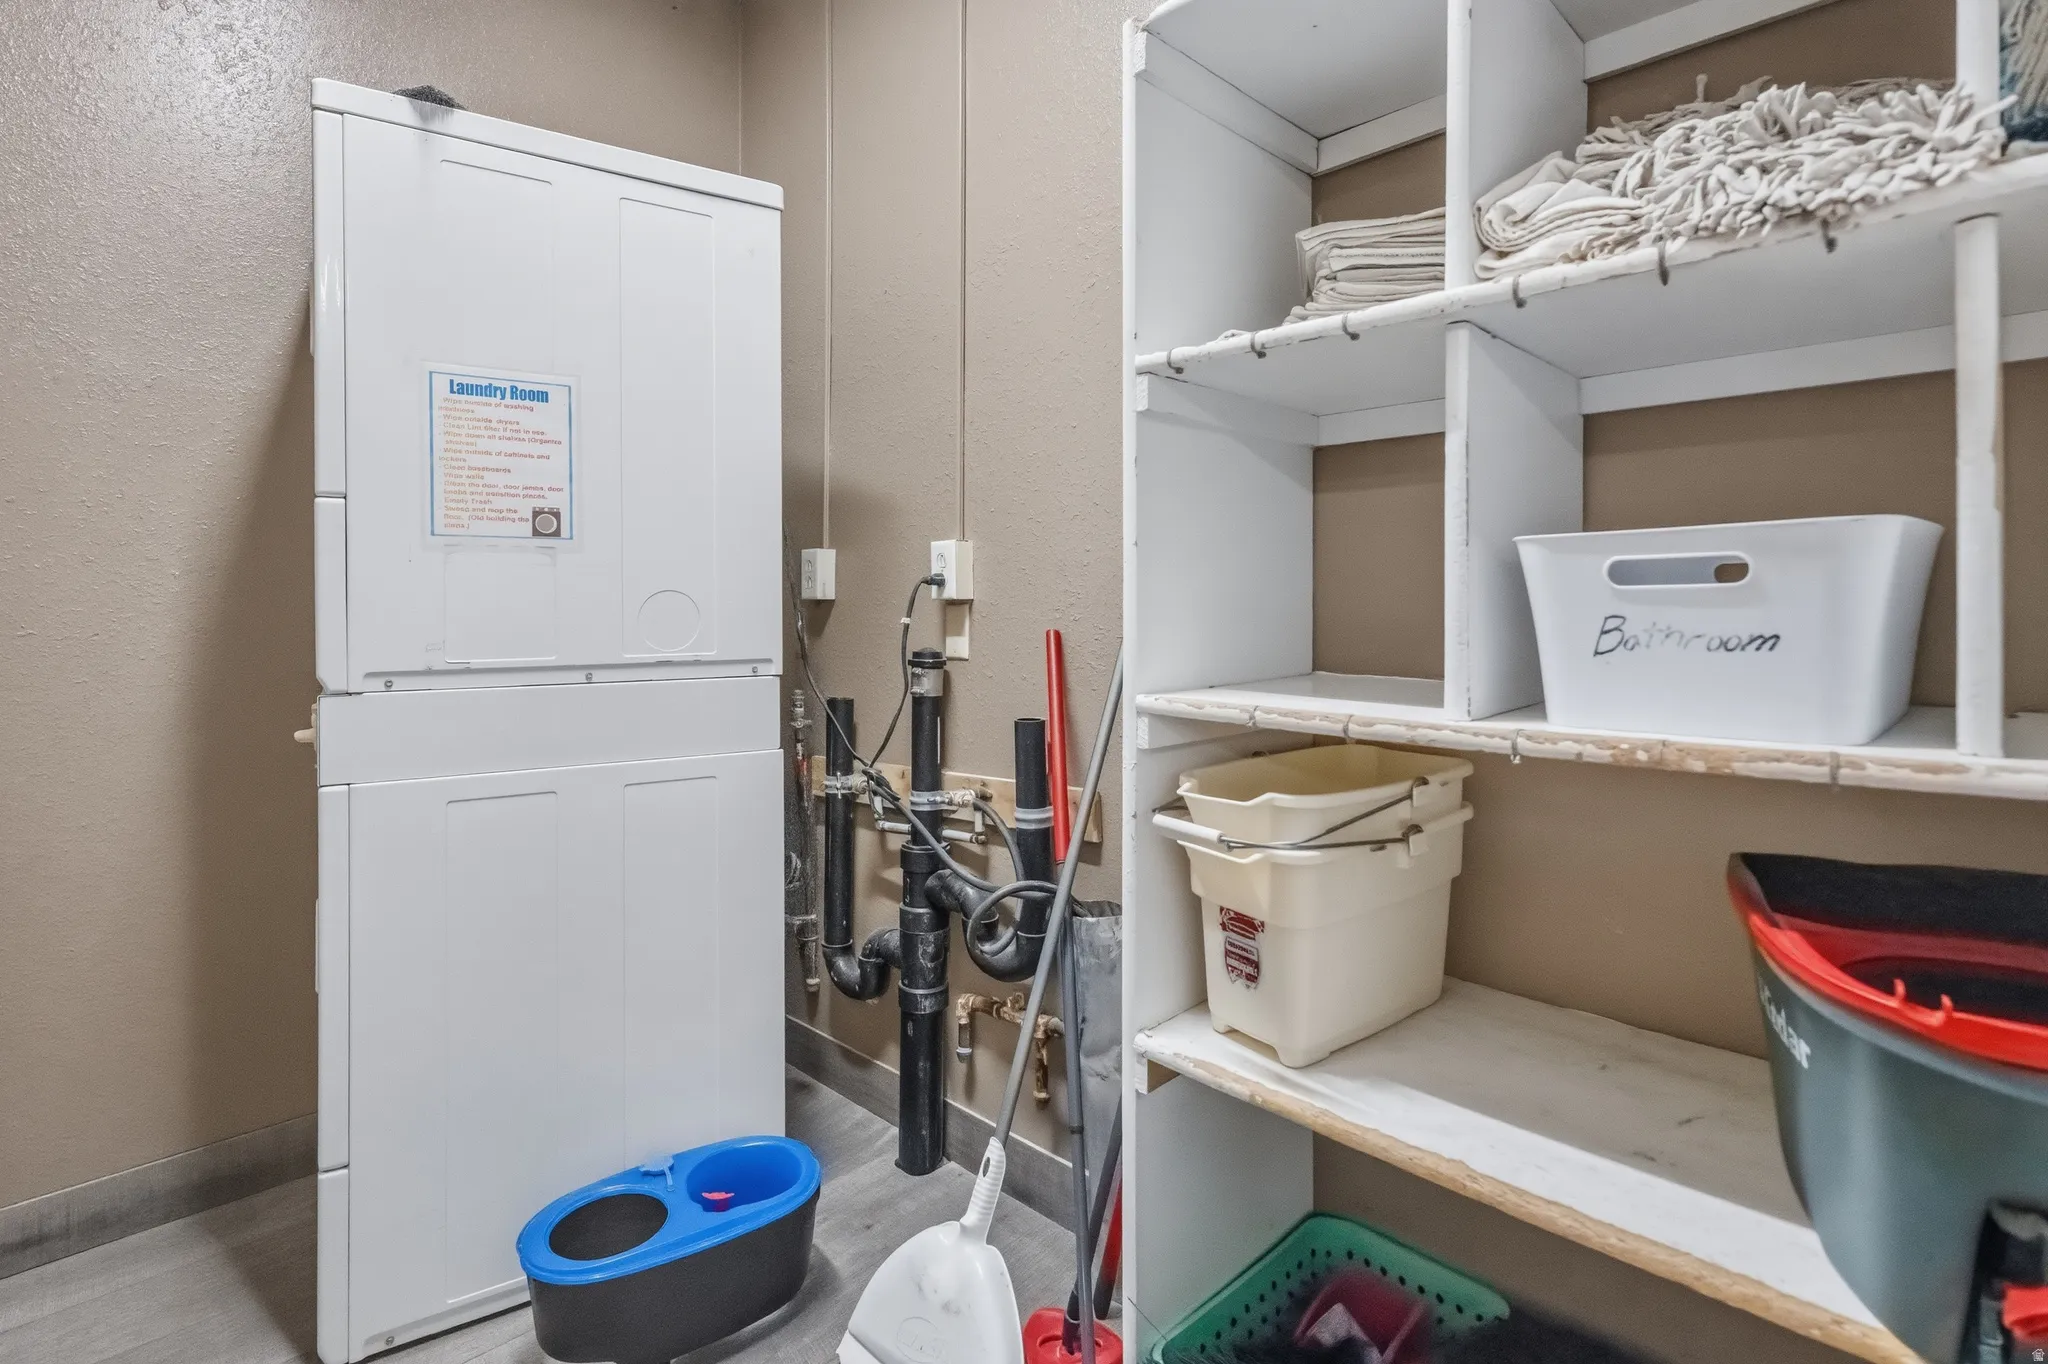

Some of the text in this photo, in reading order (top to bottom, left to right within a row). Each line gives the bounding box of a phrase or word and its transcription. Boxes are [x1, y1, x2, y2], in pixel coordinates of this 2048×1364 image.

[449, 379, 549, 403] Laundry Room
[1593, 614, 1781, 657] Bathroom
